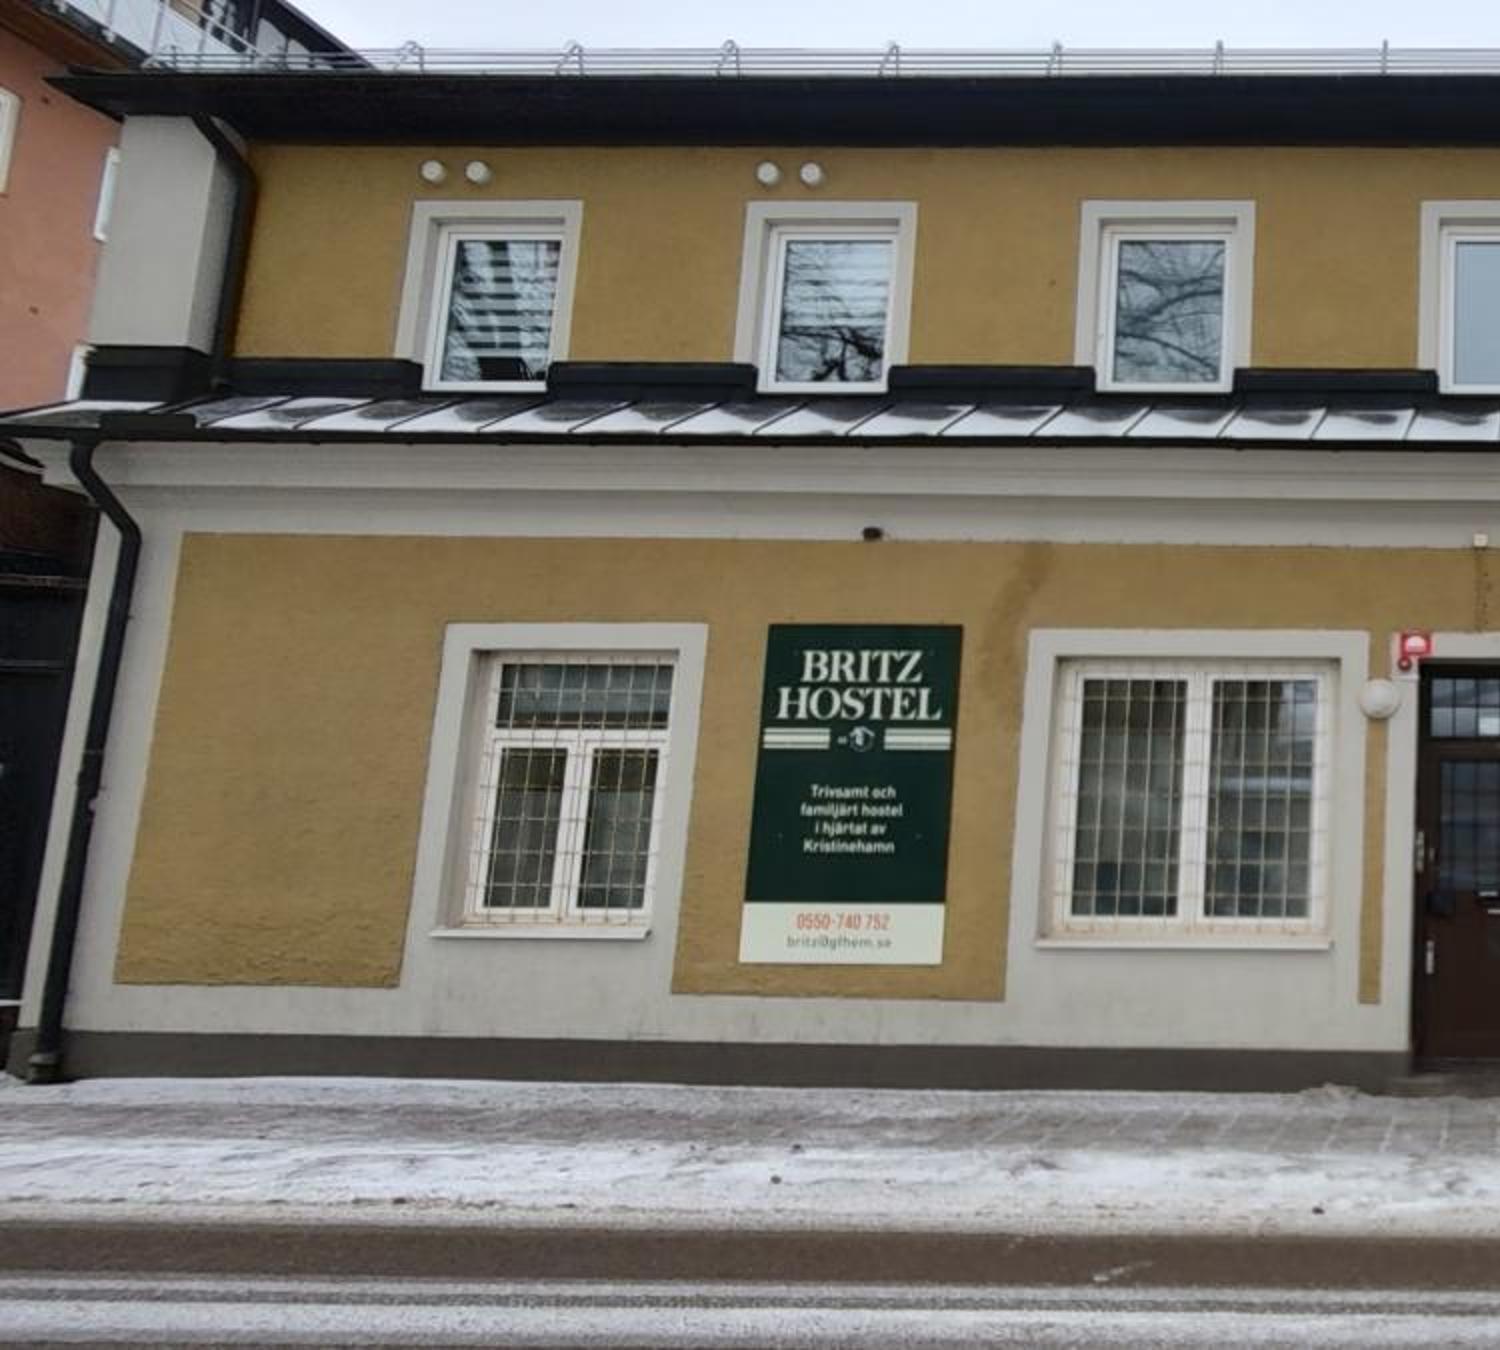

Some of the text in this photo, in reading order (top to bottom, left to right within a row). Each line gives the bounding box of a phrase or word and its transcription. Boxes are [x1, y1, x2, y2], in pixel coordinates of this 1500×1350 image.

[801, 650, 923, 683] BRITZ
[777, 687, 942, 721] HOSTEL
[811, 784, 897, 799] Trivsamt och
[800, 801, 903, 819] familjärt hostel
[822, 821, 867, 837] hjärtat
[870, 823, 887, 835] av
[803, 839, 895, 853] Kristinehamn
[797, 912, 891, 930] 0550-740 752
